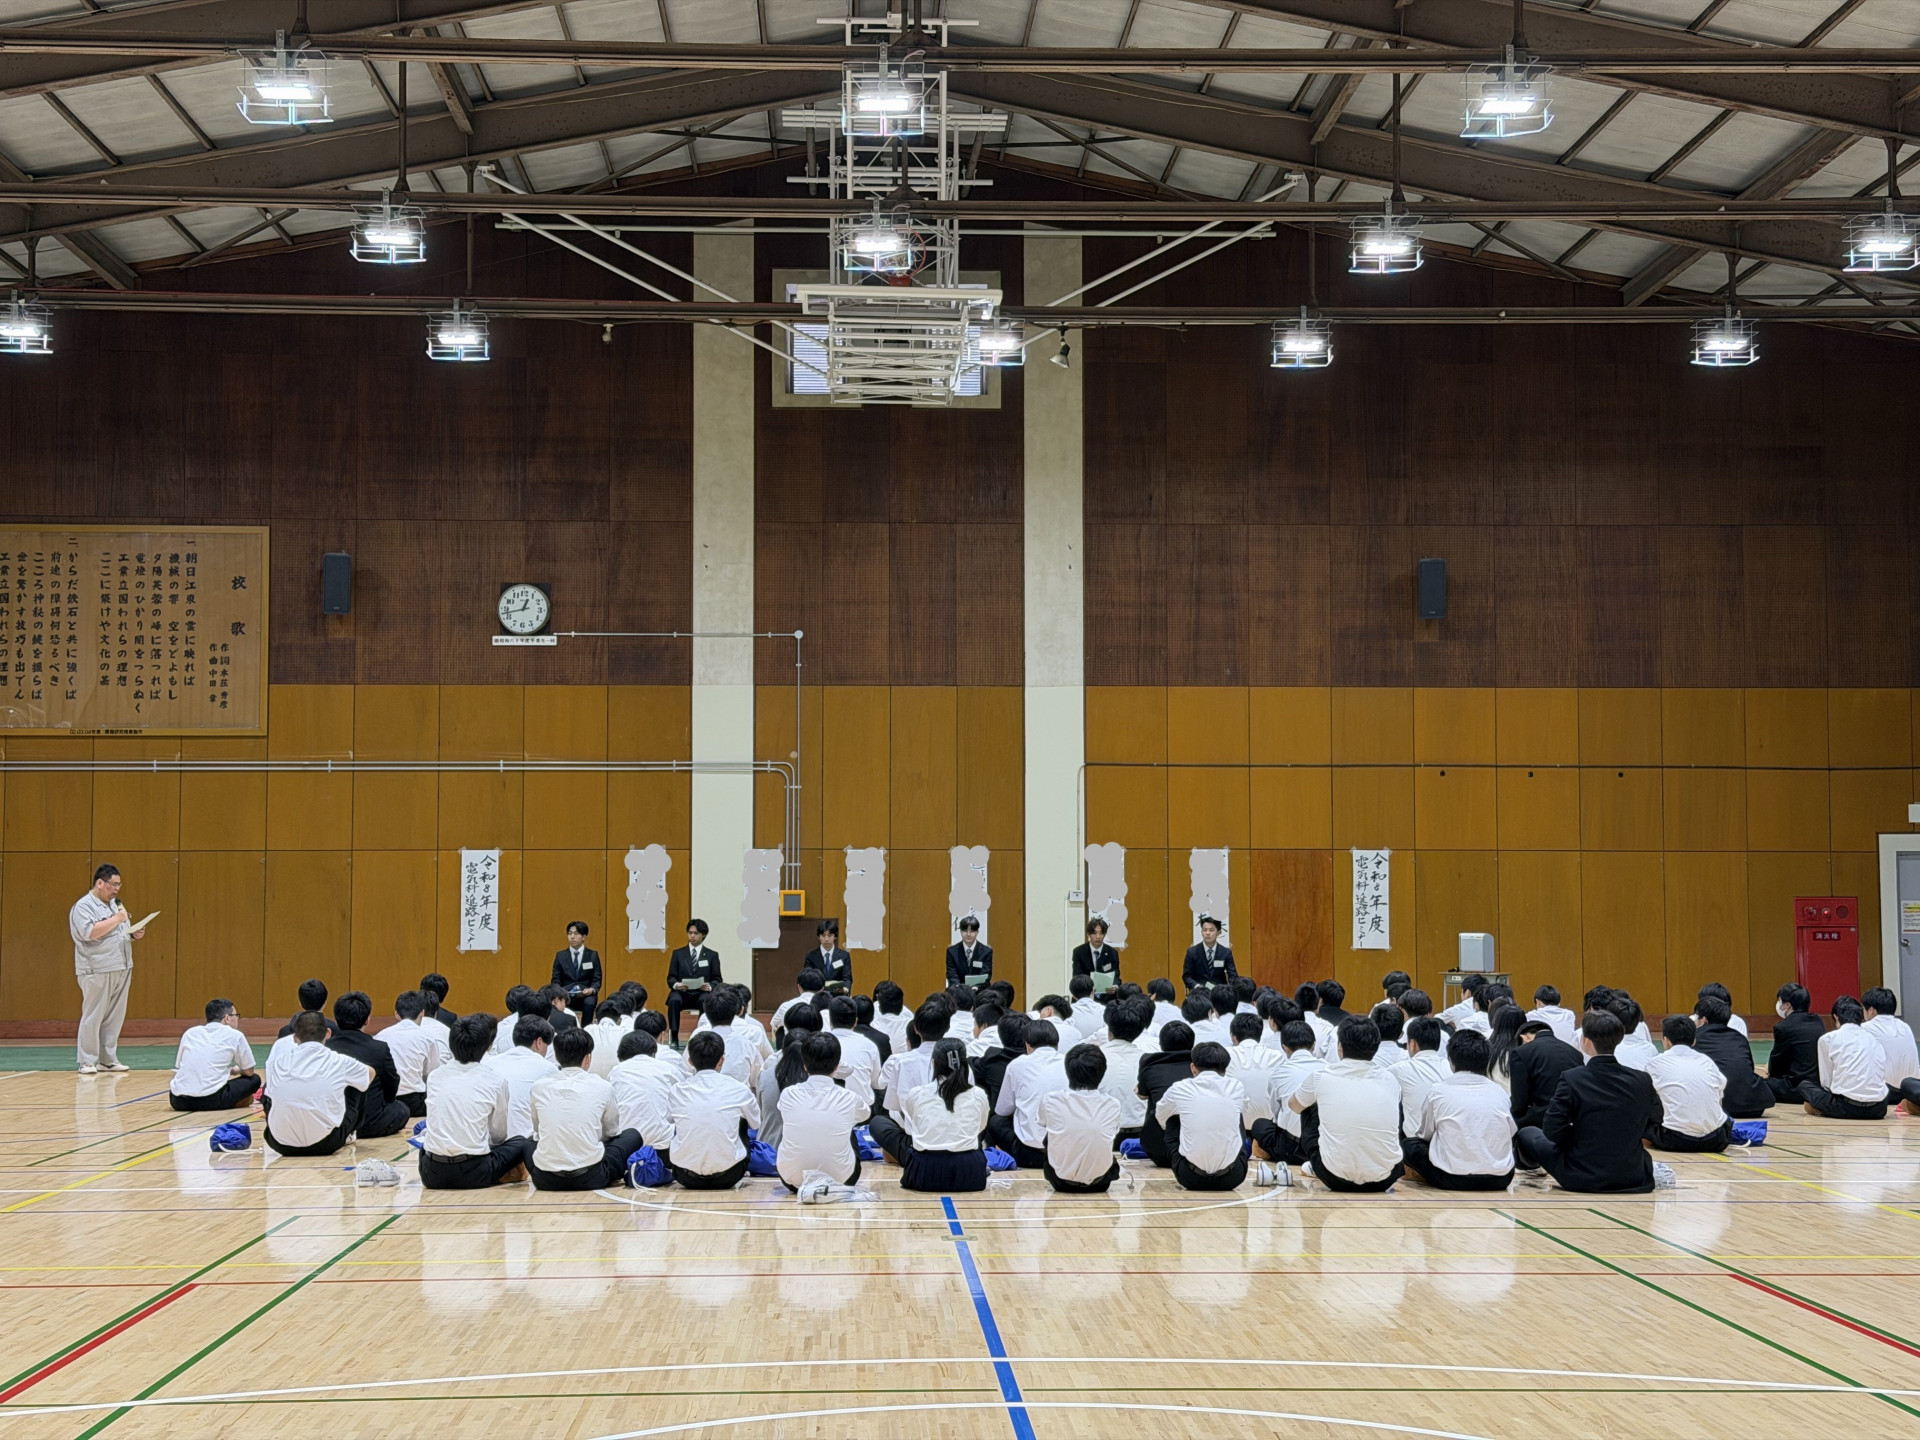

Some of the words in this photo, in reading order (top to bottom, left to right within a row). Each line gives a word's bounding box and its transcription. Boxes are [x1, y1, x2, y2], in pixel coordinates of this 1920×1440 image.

[230, 575, 247, 636] 校歌
[479, 854, 497, 931] 令和8年度
[1369, 852, 1388, 934] 令和8年度
